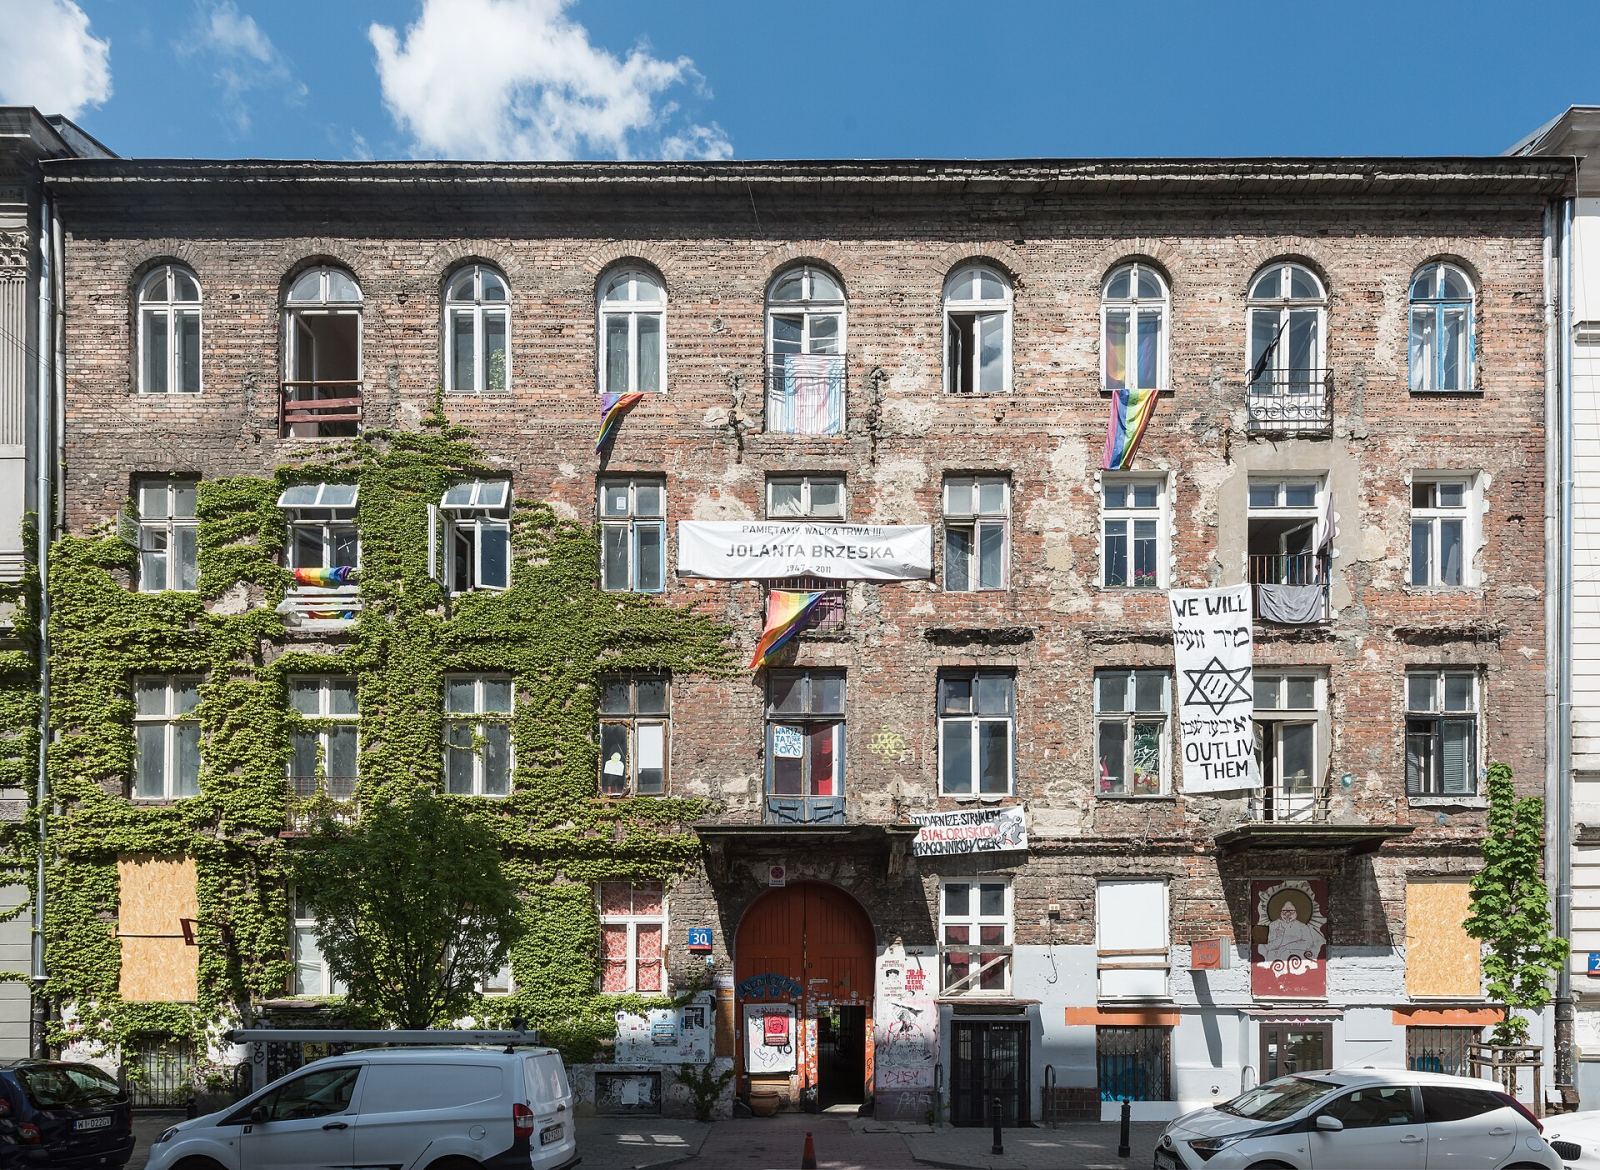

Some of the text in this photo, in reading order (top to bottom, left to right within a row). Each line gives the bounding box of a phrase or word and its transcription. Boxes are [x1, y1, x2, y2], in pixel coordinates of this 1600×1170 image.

[805, 526, 838, 537] WALKA
[840, 527, 869, 537] TRWA
[726, 543, 895, 560] JOLANTA BRZESKA
[815, 565, 832, 574] 2011
[1172, 594, 1248, 617] WE WILL
[1200, 760, 1249, 781] THEM
[693, 933, 707, 944] 30
